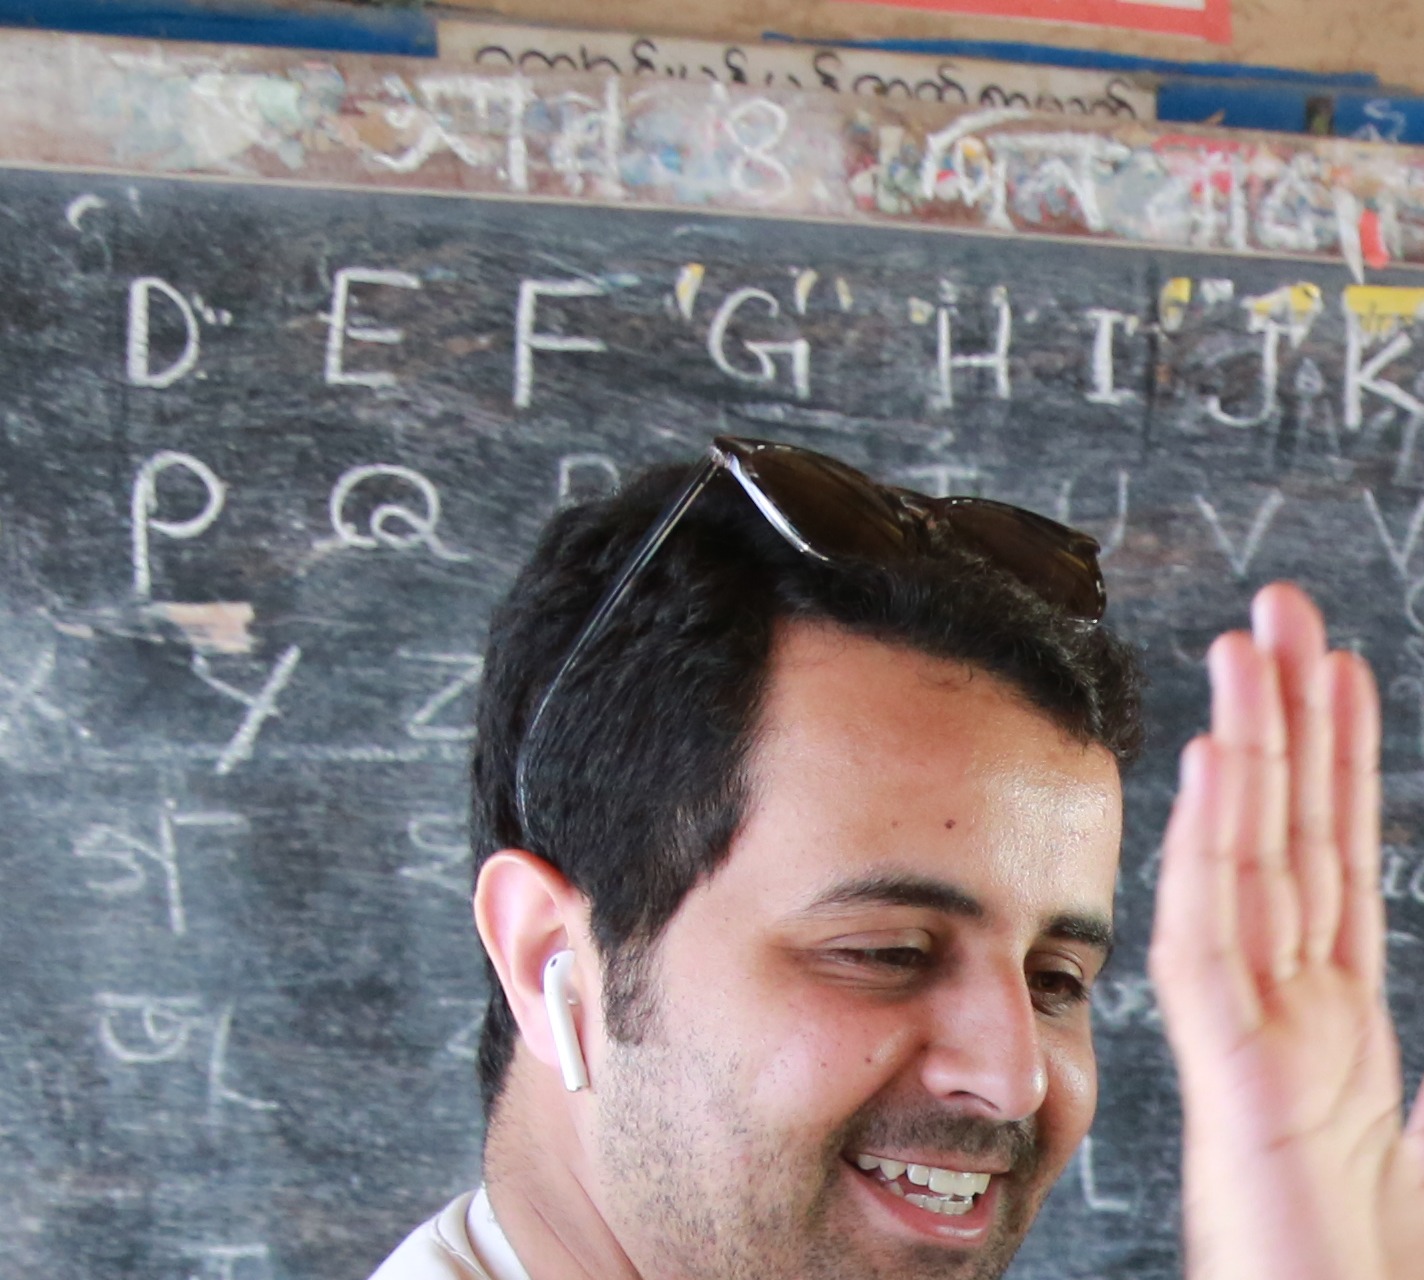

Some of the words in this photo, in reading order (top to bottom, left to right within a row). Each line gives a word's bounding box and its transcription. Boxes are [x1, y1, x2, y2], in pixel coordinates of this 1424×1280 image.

[127, 276, 201, 388] D
[320, 267, 421, 387] E
[515, 278, 607, 408] F
[934, 288, 1011, 408] H
[1085, 308, 1137, 403] I
[133, 450, 225, 595] P
[313, 463, 470, 562] Q
[1196, 489, 1285, 577] V
[190, 643, 302, 776] Y
